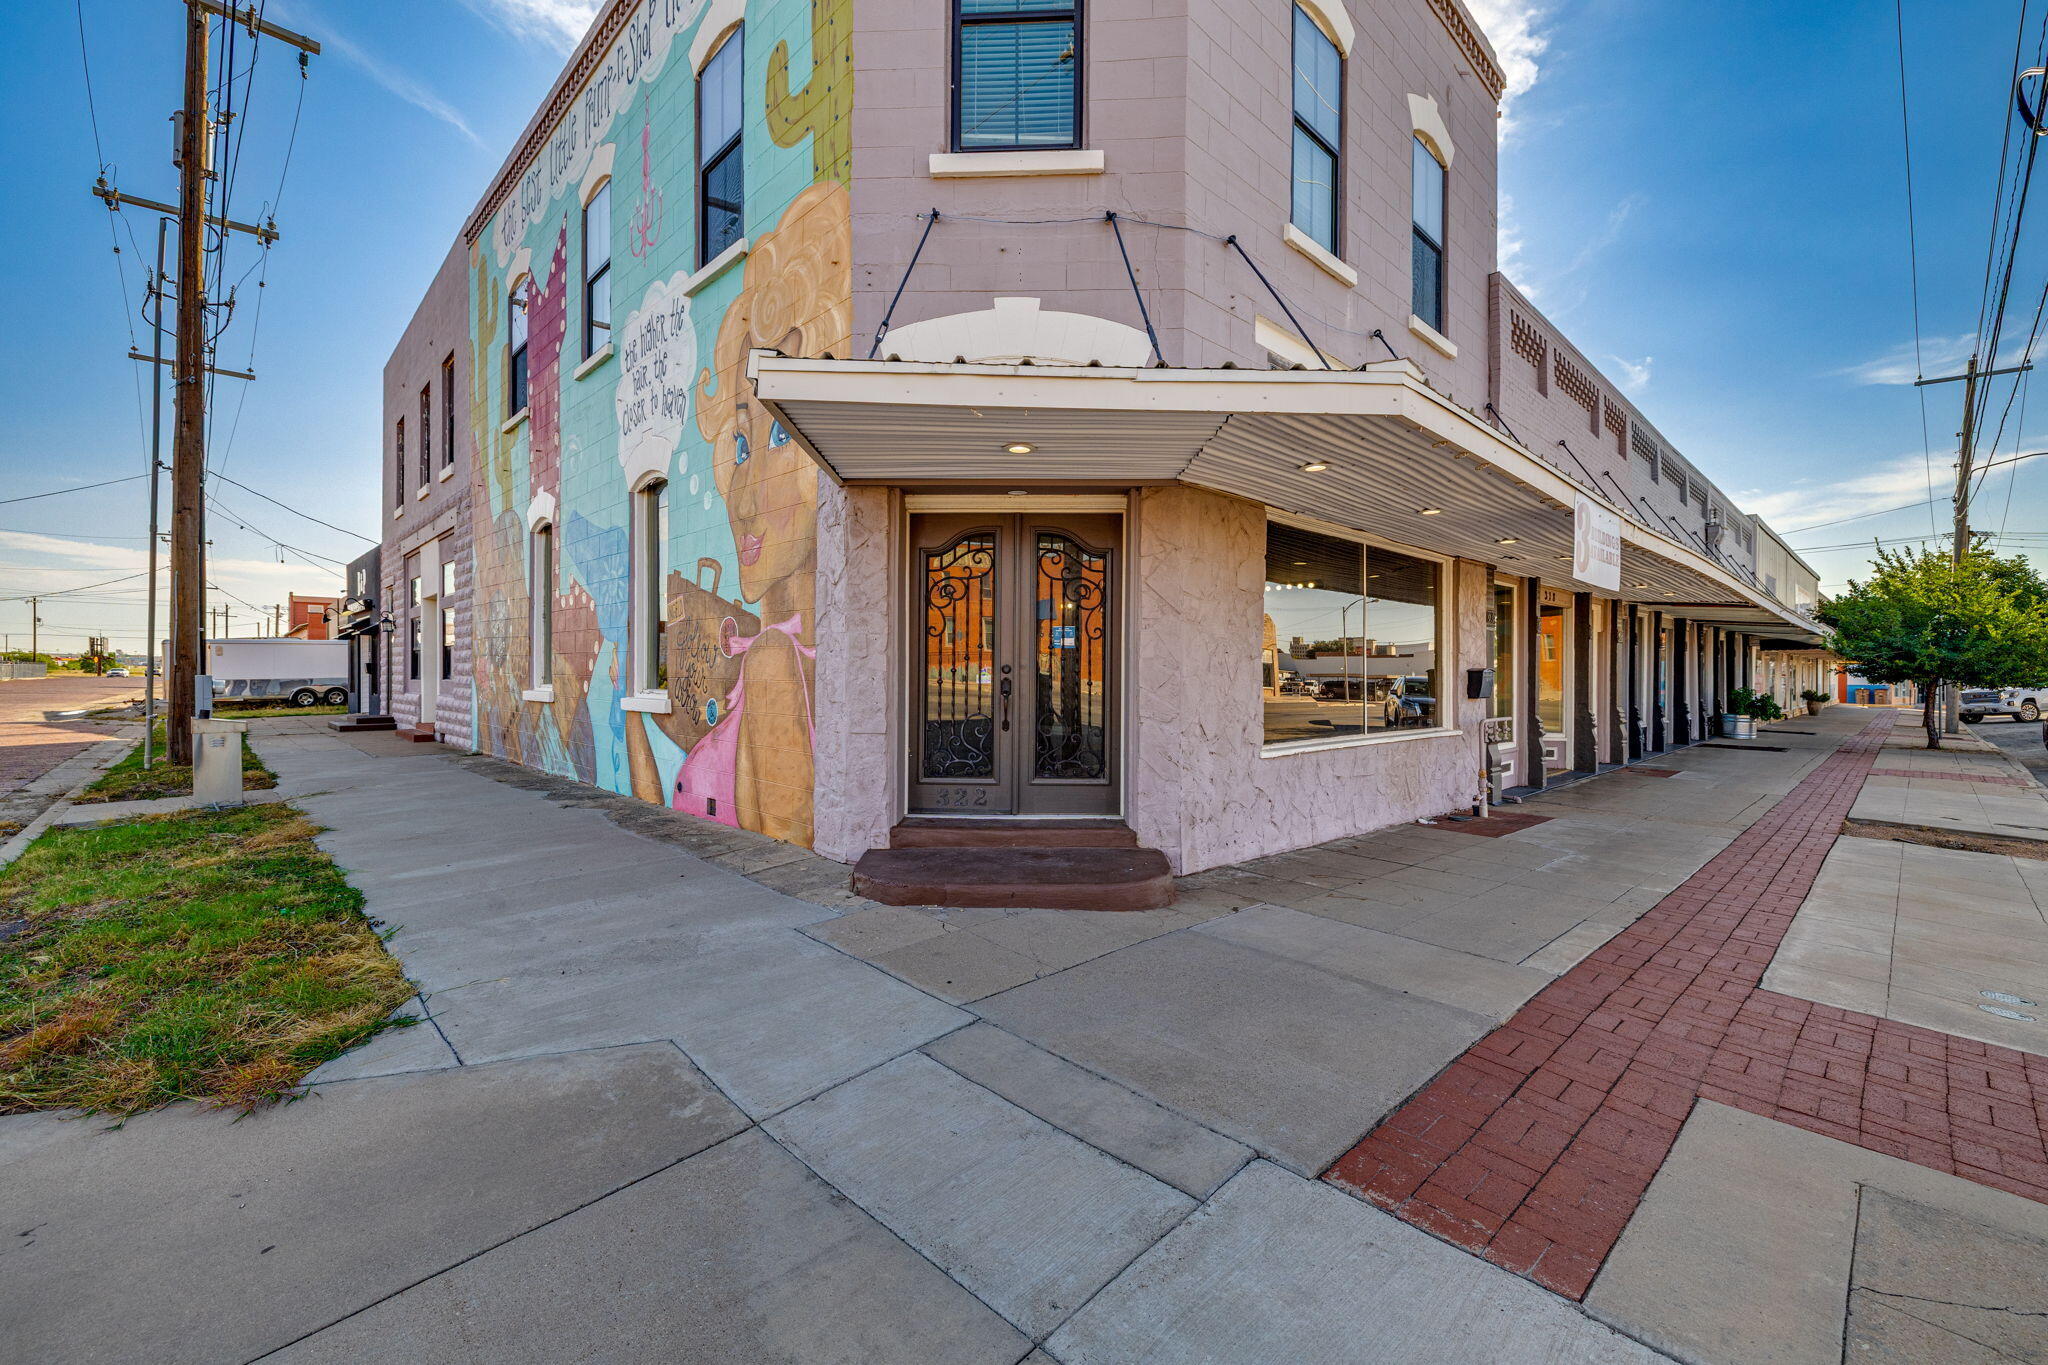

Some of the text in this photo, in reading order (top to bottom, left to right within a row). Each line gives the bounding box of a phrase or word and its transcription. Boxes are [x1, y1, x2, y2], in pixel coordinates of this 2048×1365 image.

[624, 340, 637, 373] the
[670, 297, 685, 337] the
[653, 351, 668, 383] the
[650, 389, 658, 415] to
[1577, 502, 1591, 574] 3
[935, 786, 988, 807] 322
